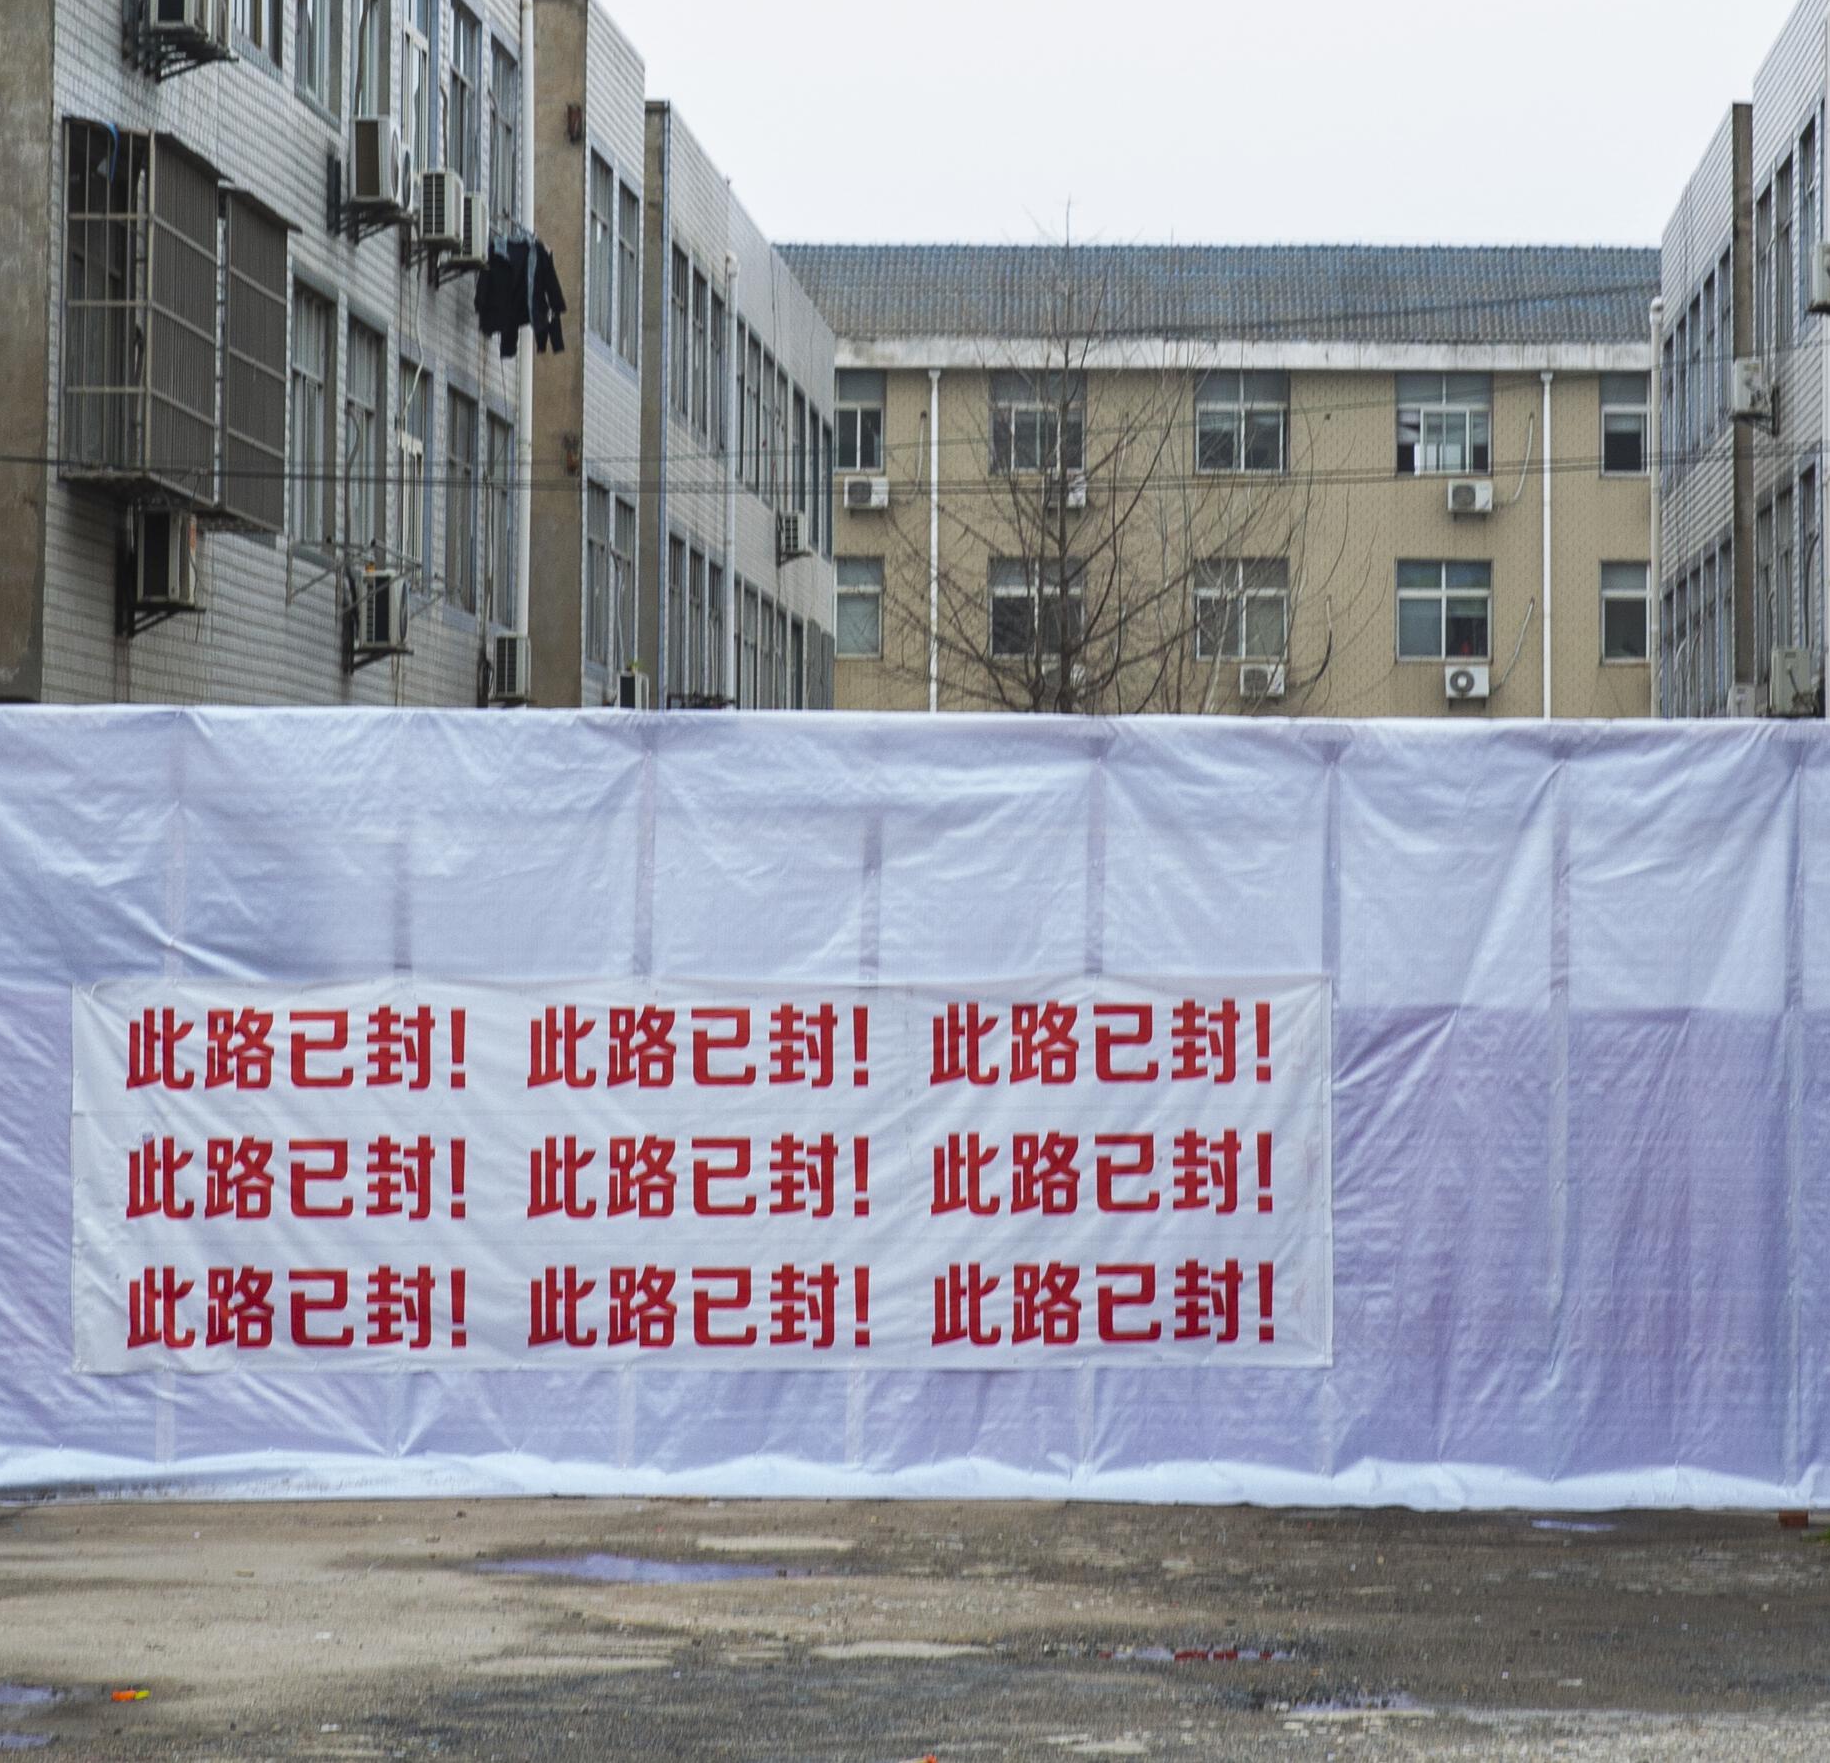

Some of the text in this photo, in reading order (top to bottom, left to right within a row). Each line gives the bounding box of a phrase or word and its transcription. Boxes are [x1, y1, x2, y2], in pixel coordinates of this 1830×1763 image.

[126, 999, 1272, 1091] 此路已封! 此路已封! 此路已封!
[126, 1129, 1274, 1220] 此路已封! 此路已封! 此路已封!
[126, 1259, 1275, 1350] 此路已封! 此路已封! 此路已封!
